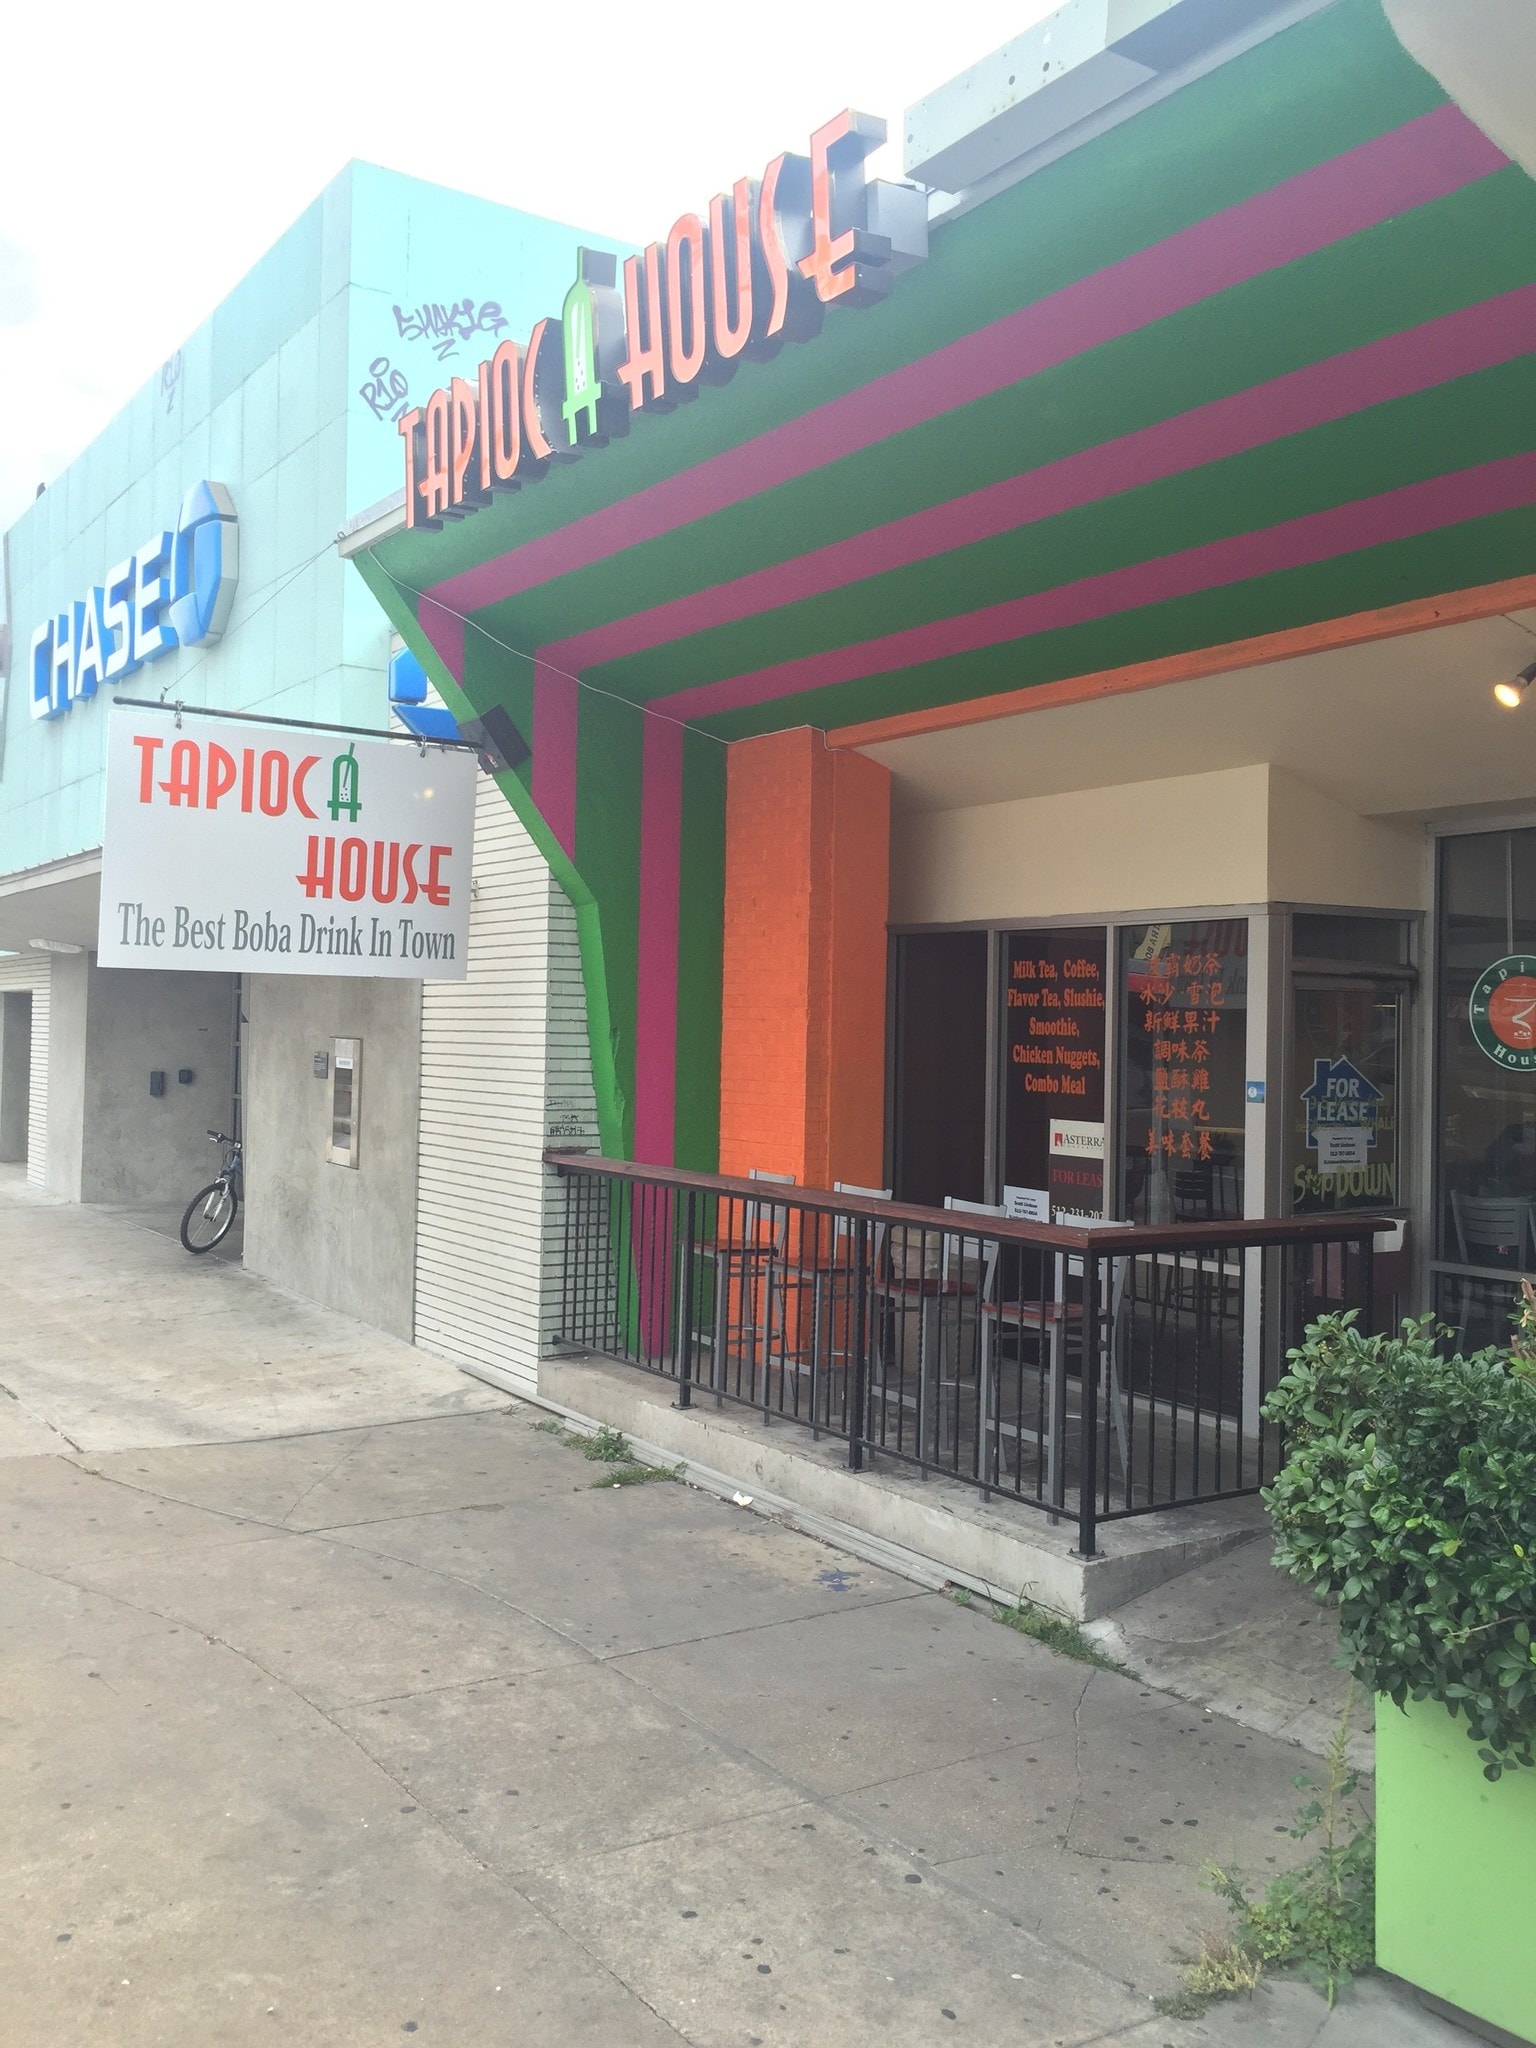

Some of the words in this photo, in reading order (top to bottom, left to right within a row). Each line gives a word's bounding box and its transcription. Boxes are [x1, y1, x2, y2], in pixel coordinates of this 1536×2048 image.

[399, 246, 604, 529] TAPIOCA
[616, 108, 870, 410] HOUSE
[30, 531, 175, 719] CHASE
[133, 735, 362, 823] TAPIOCA
[295, 835, 453, 906] HOUSE
[117, 902, 166, 947] The
[172, 905, 226, 950] Best
[233, 909, 291, 953] Boba
[299, 913, 363, 956] Drink
[369, 917, 392, 957] In
[399, 919, 455, 960] Town
[1013, 960, 1036, 979] Milk
[1038, 960, 1058, 982] Tea,
[1063, 959, 1099, 981] Coffee,
[1007, 988, 1039, 1007] Flavor
[1041, 988, 1061, 1010] Tea,
[1063, 988, 1105, 1011] Slushie,
[1029, 1016, 1080, 1037] Smoothie,
[1143, 1010, 1221, 1034] 新鮮果汁
[1012, 1044, 1053, 1064] Chicken
[1055, 1046, 1100, 1070] Nuggets,
[1154, 1039, 1210, 1063] 調味茶
[1493, 1044, 1536, 1065] Hou
[1024, 1073, 1058, 1093] Combo
[1061, 1074, 1086, 1095] Meal
[1326, 1078, 1360, 1098] FOR
[1317, 1101, 1369, 1121] LEASE
[1053, 1168, 1074, 1184] FOR
[1076, 1171, 1103, 1188] LEAS
